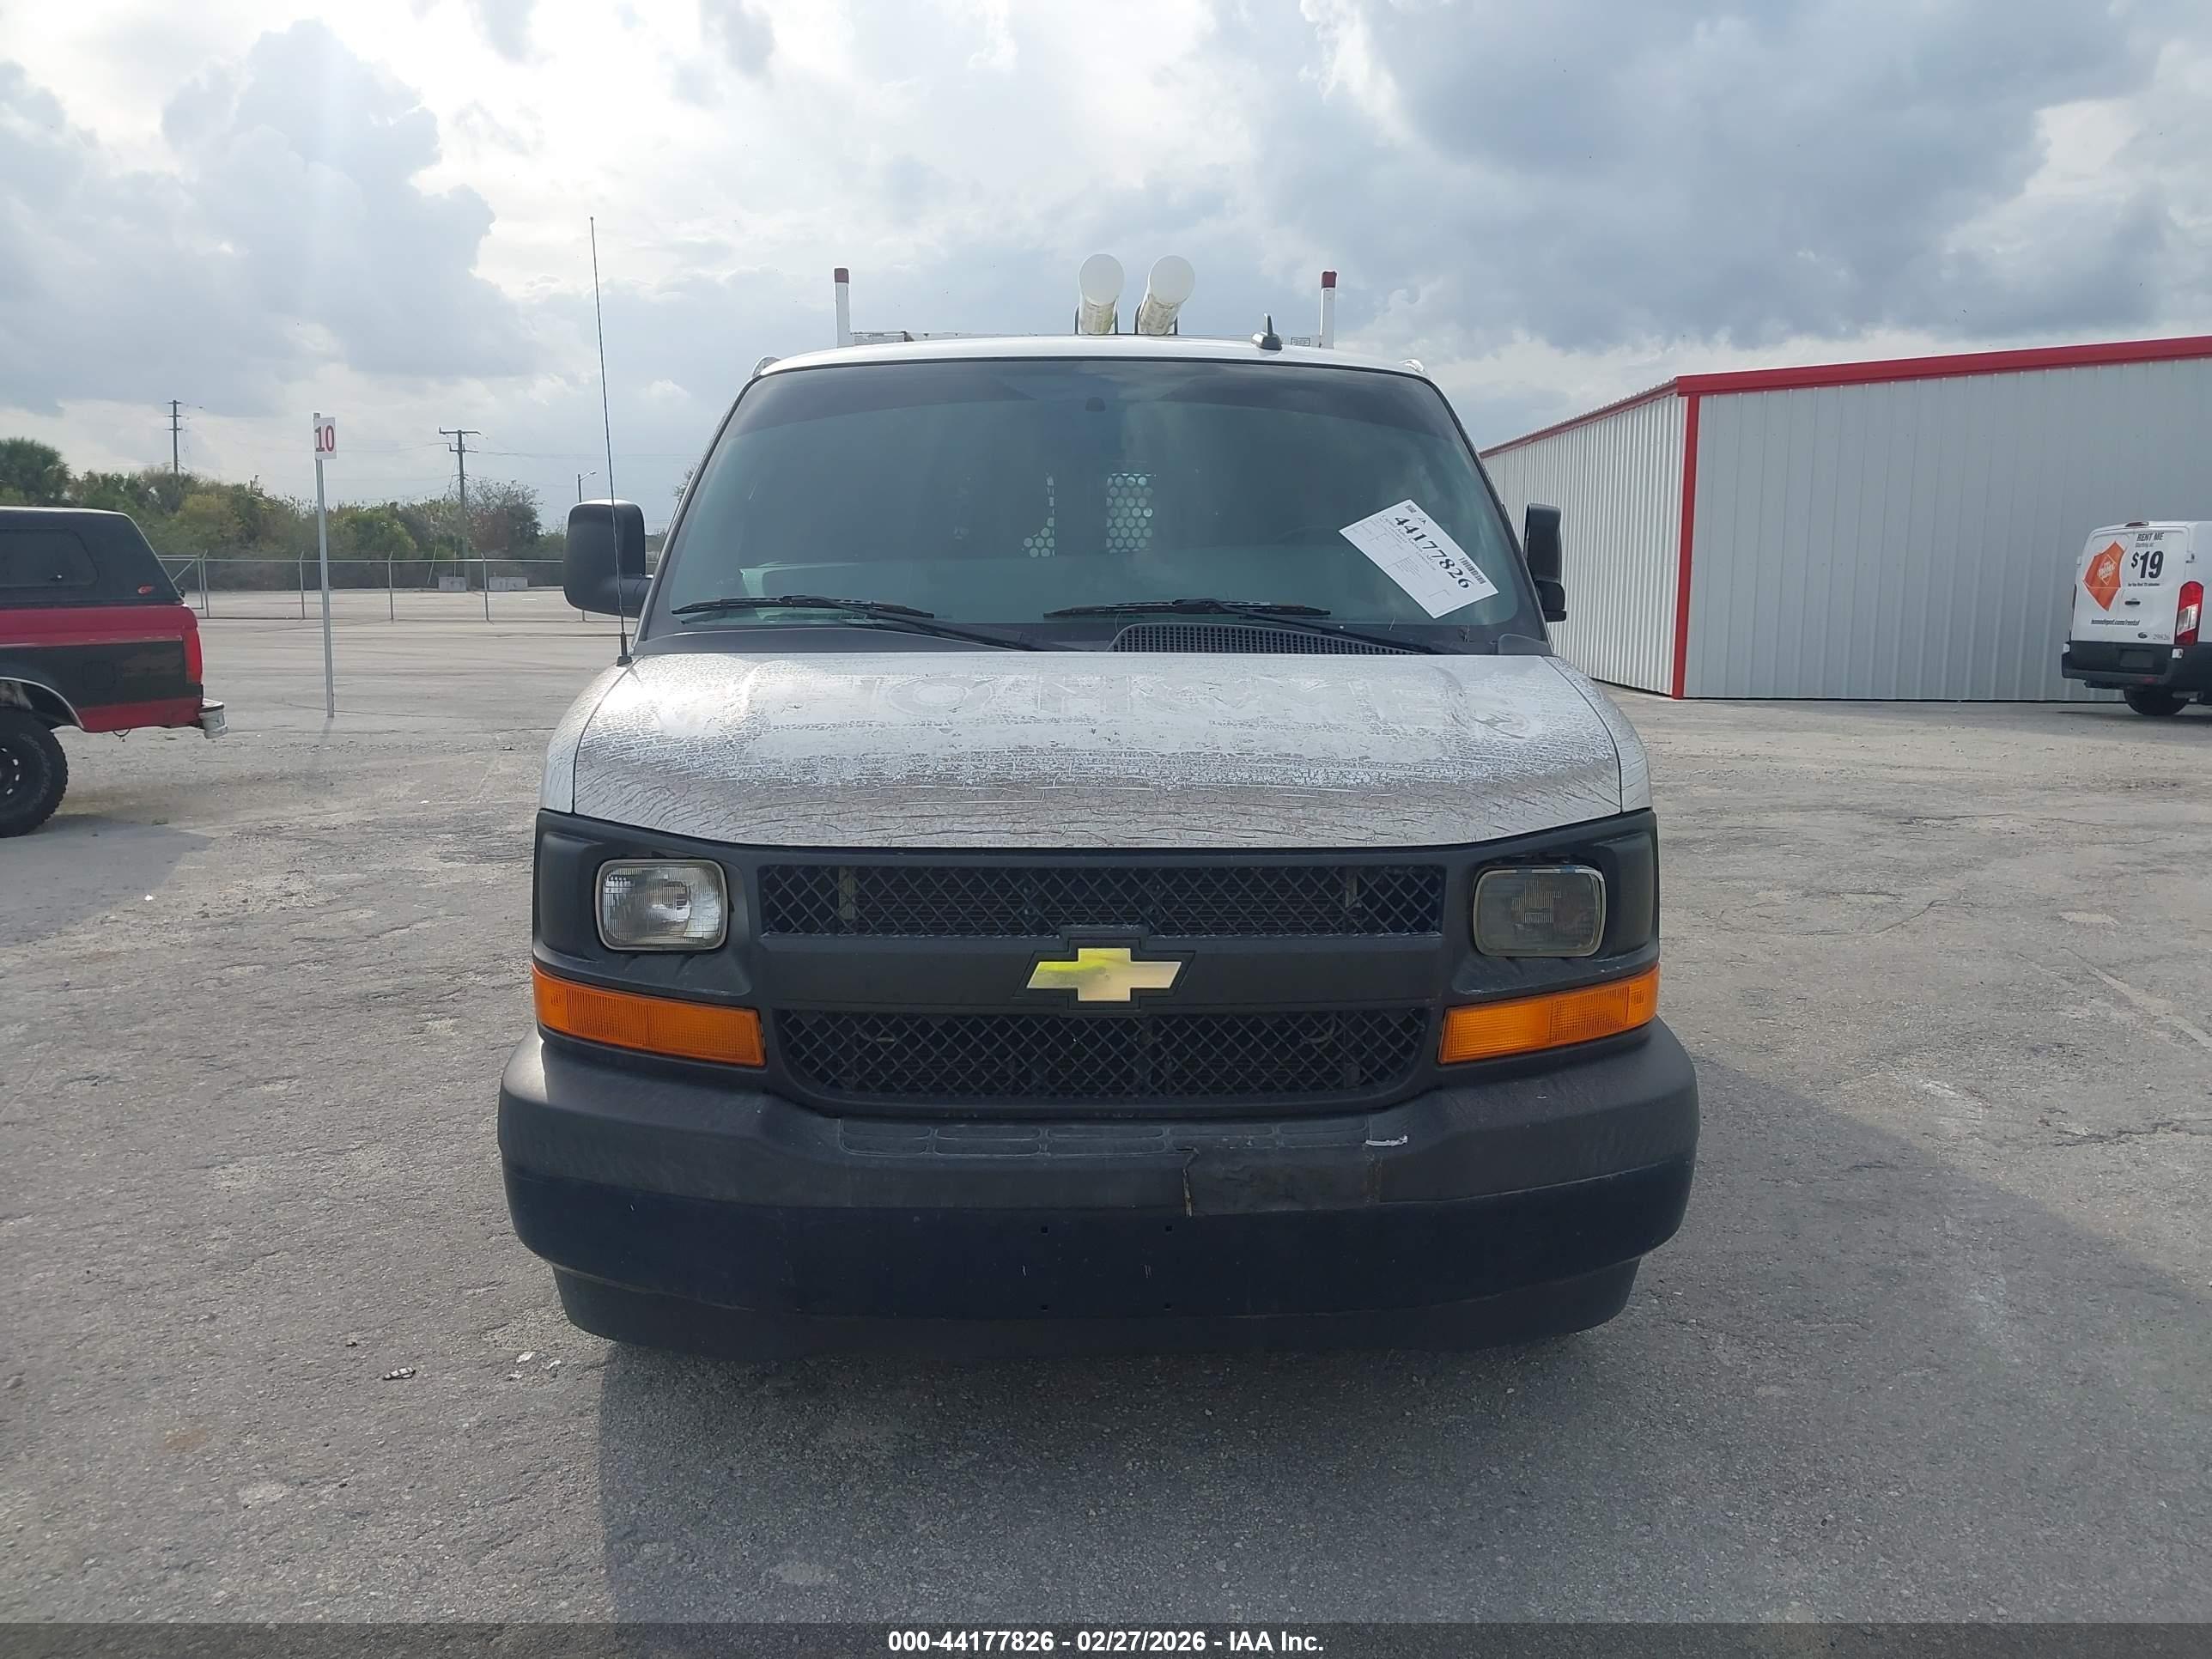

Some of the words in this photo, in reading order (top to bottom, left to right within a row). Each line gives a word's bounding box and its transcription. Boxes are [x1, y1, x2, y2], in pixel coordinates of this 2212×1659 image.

[314, 425, 335, 452] 10
[2154, 532, 2164, 540] ME
[1395, 517, 1474, 588] 44177826
[2131, 550, 2164, 578] $19
